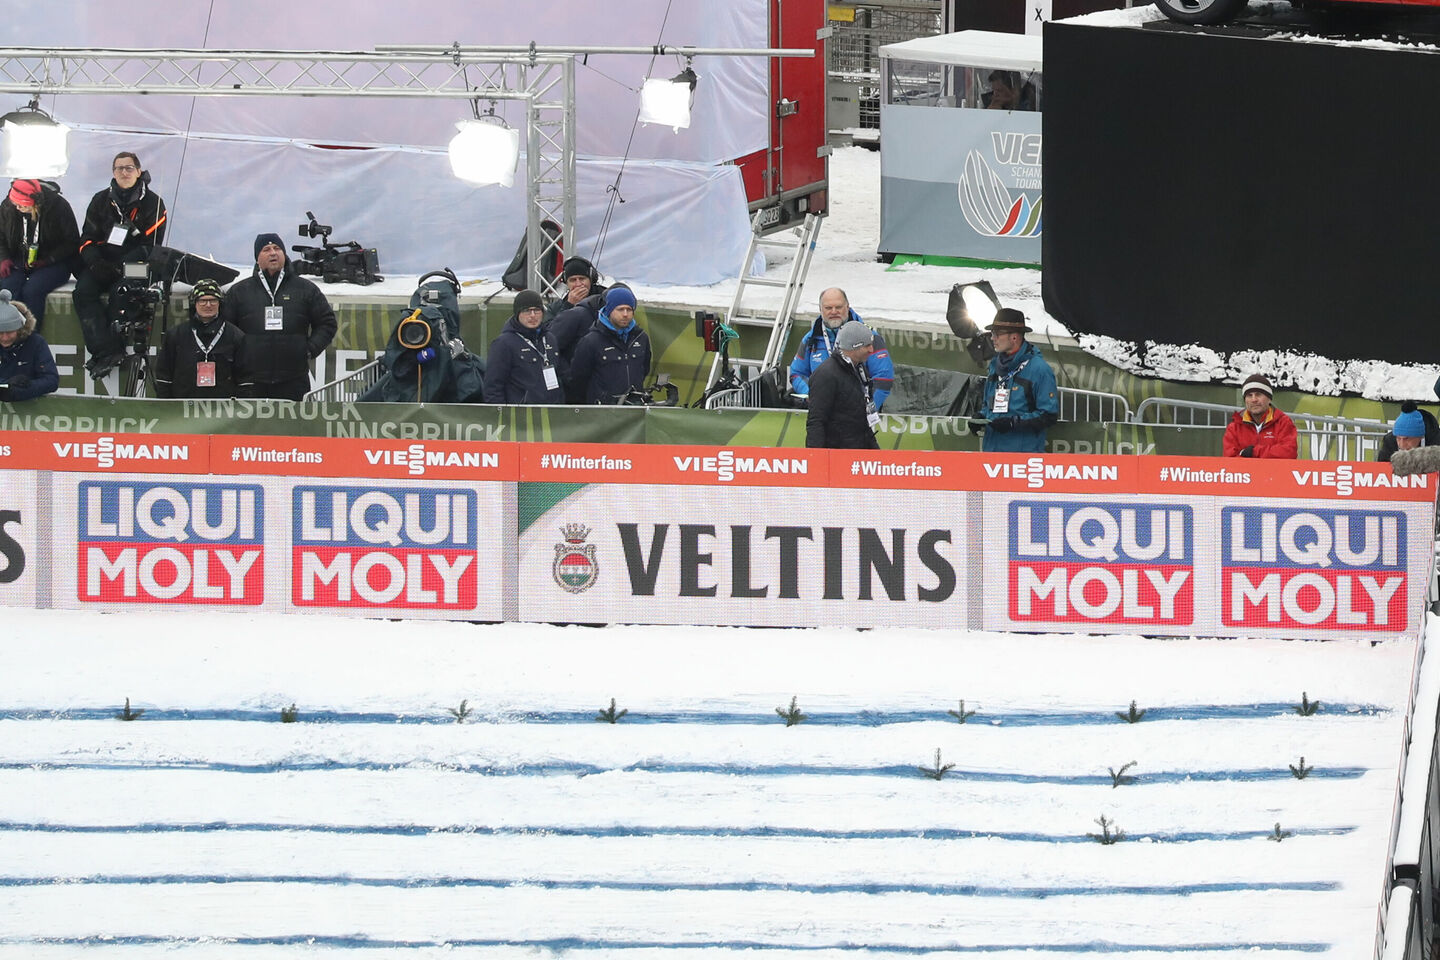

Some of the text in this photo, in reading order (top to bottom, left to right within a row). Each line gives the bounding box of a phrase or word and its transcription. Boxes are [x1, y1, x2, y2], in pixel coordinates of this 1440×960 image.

[991, 131, 1043, 166] VIE
[1011, 166, 1042, 178] SCHAN
[53, 437, 189, 468] VIESSMANN
[232, 447, 323, 464] #Winterfans
[364, 444, 499, 475] VIESSMANN
[540, 454, 632, 471] #Winterfans
[673, 451, 808, 482] VIESSMANN
[851, 461, 942, 477] #Winterfans
[983, 458, 1118, 488] VIESSMANN
[1160, 467, 1251, 484] #Winterfans
[1292, 465, 1427, 496] VIESSMANN
[87, 486, 255, 542] LIQUI
[302, 491, 468, 546] LIQUI
[1017, 506, 1185, 563] LIQUI
[1231, 512, 1398, 568] LIQUI
[87, 547, 261, 599] MOLY
[302, 552, 475, 604] MOLY
[616, 523, 957, 602] VELTINS
[1017, 566, 1190, 620] MOLY
[1231, 573, 1404, 626] MOLY
